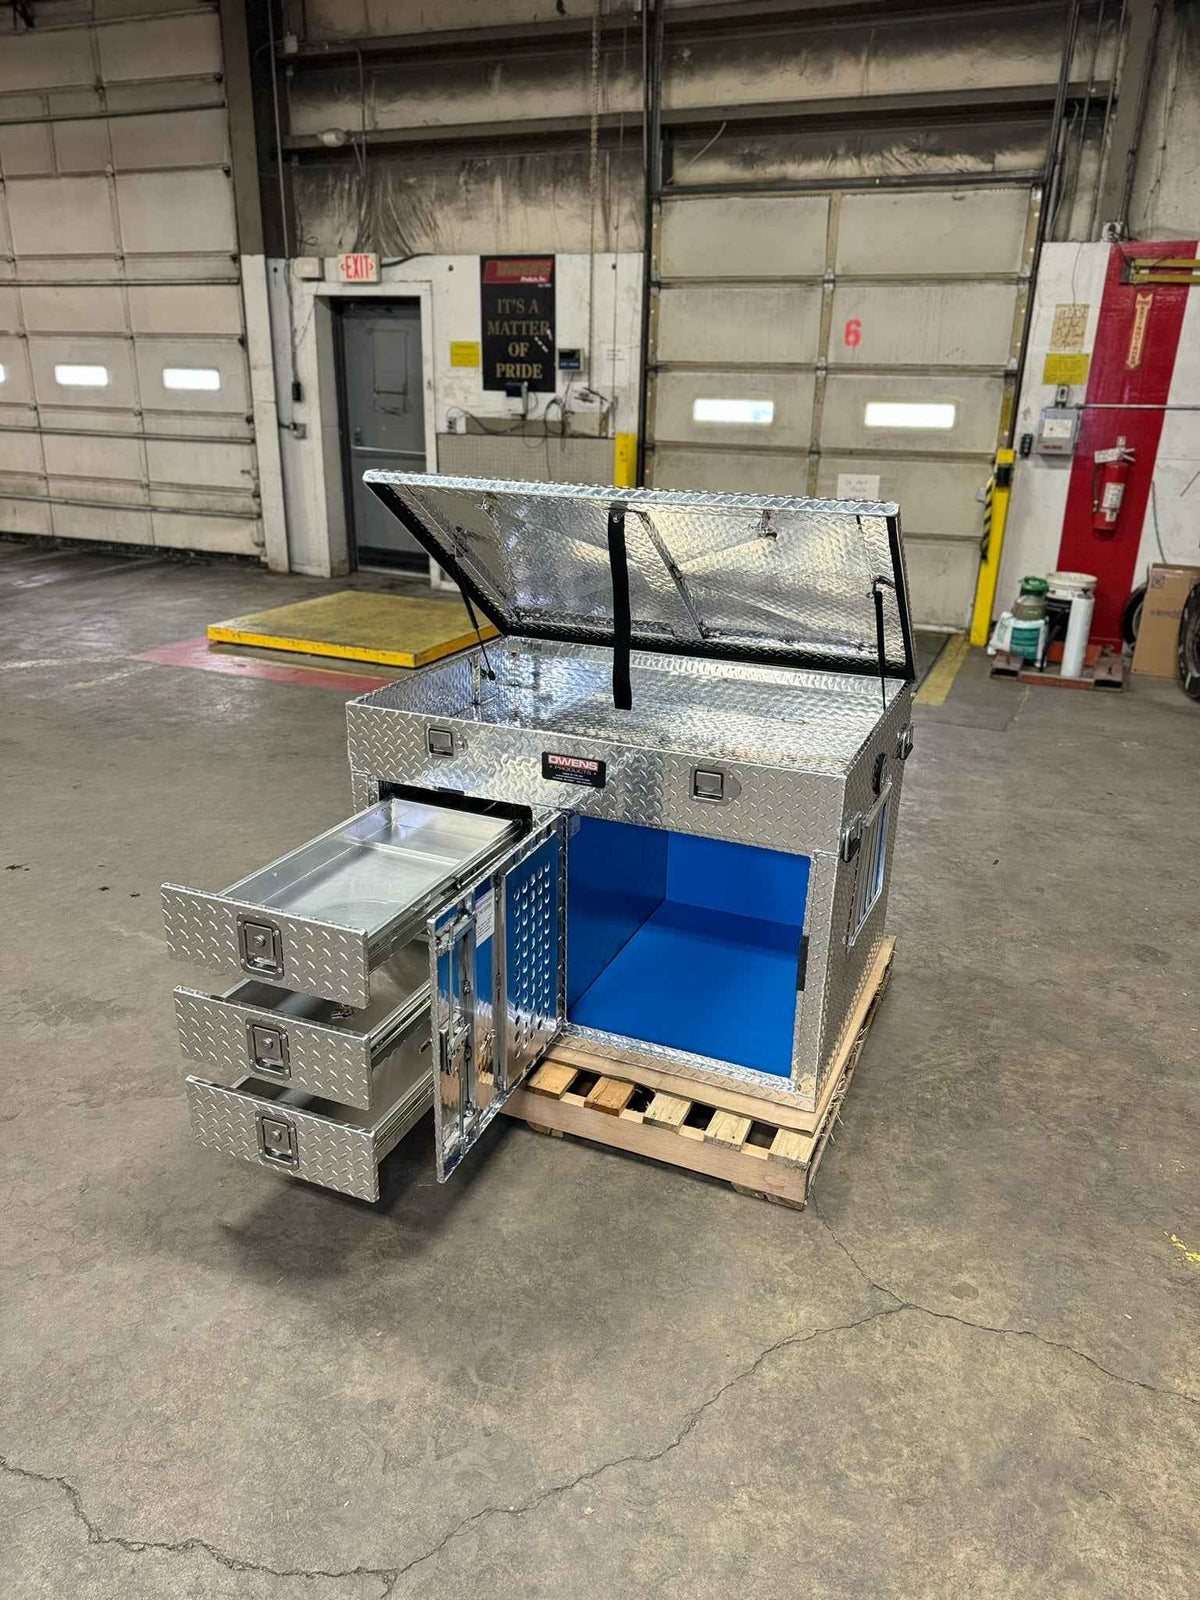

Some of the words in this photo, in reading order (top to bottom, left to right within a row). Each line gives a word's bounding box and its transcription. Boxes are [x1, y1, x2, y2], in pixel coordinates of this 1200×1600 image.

[345, 254, 371, 279] EXIT
[497, 298, 525, 314] IT'S
[528, 298, 540, 314] A
[487, 320, 551, 336] MATTER
[844, 318, 862, 347] 6
[508, 342, 530, 357] OF
[496, 363, 543, 379] PRIDE
[548, 755, 599, 771] OWENS
